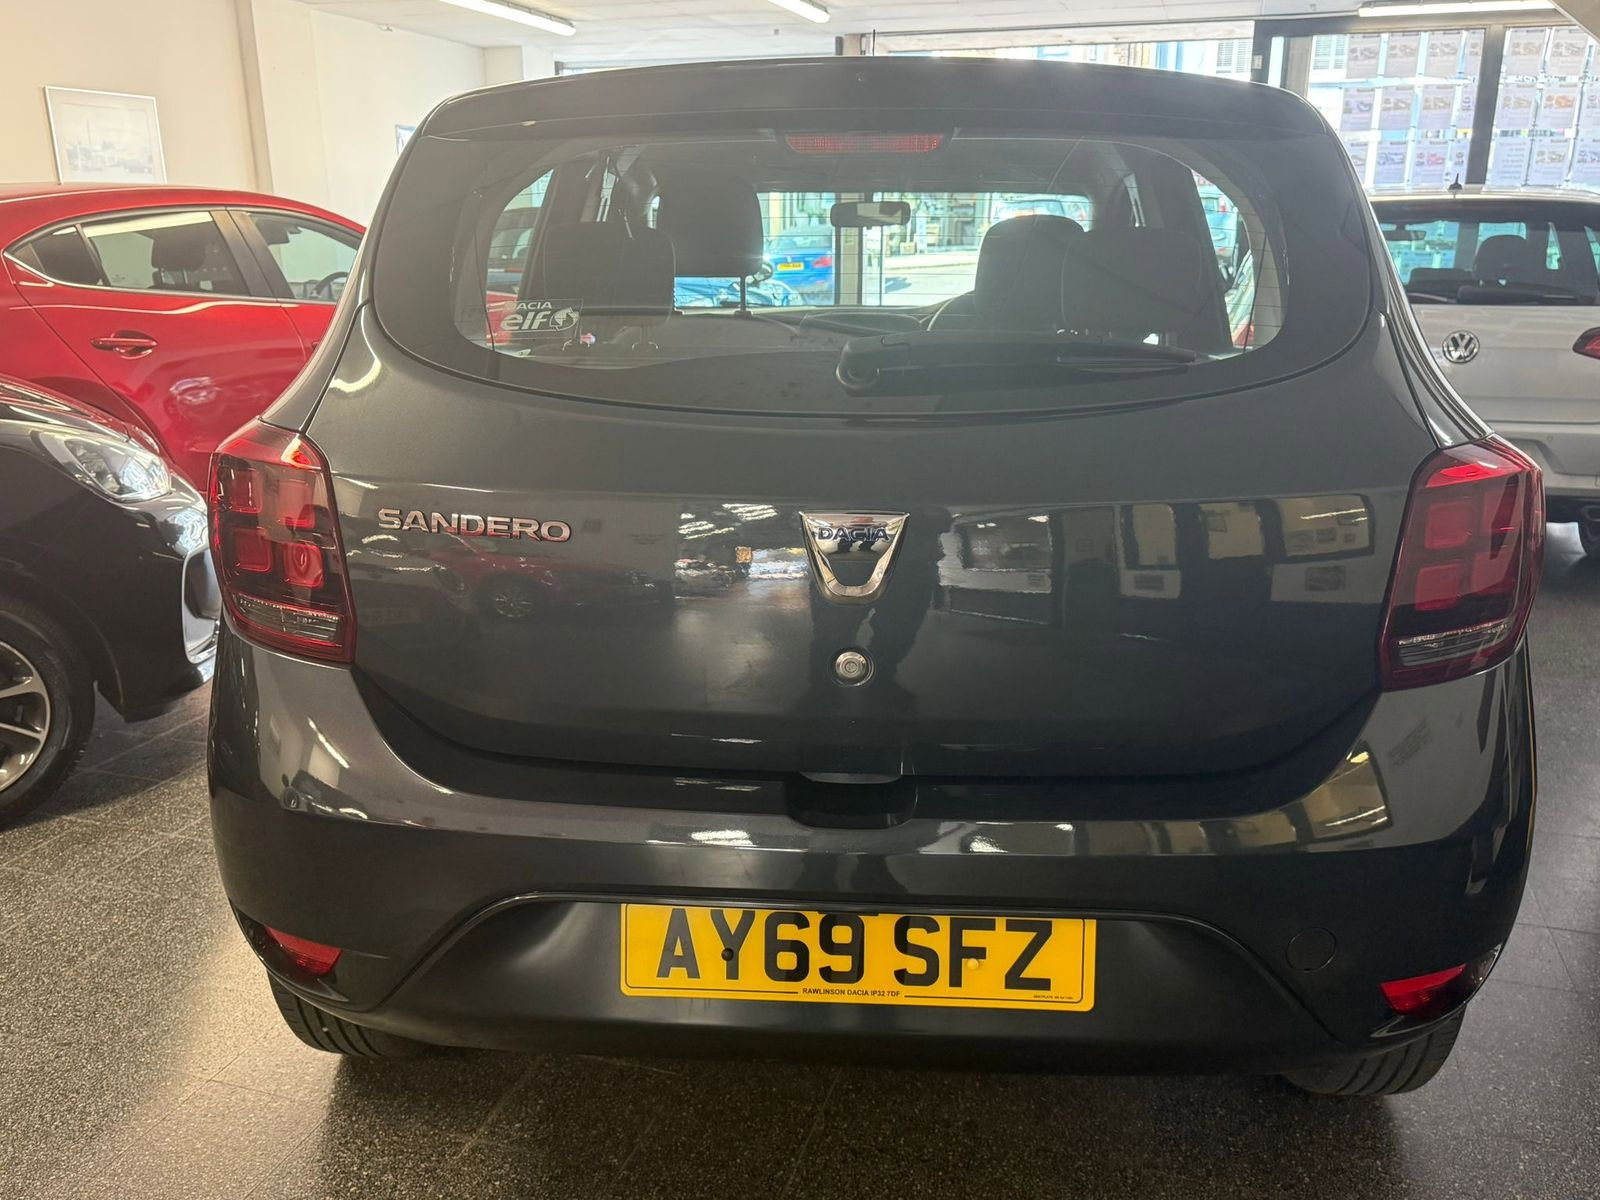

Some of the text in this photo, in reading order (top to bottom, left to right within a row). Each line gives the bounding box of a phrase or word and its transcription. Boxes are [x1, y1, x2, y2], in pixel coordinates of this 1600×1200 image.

[505, 302, 553, 310] ACIA
[500, 310, 552, 331] elf
[377, 507, 571, 543] SANDERO
[817, 526, 890, 542] DACIA
[656, 908, 1053, 992] AY69 SFZ
[802, 987, 845, 996] RAWLINSON
[847, 989, 869, 997] DACIA
